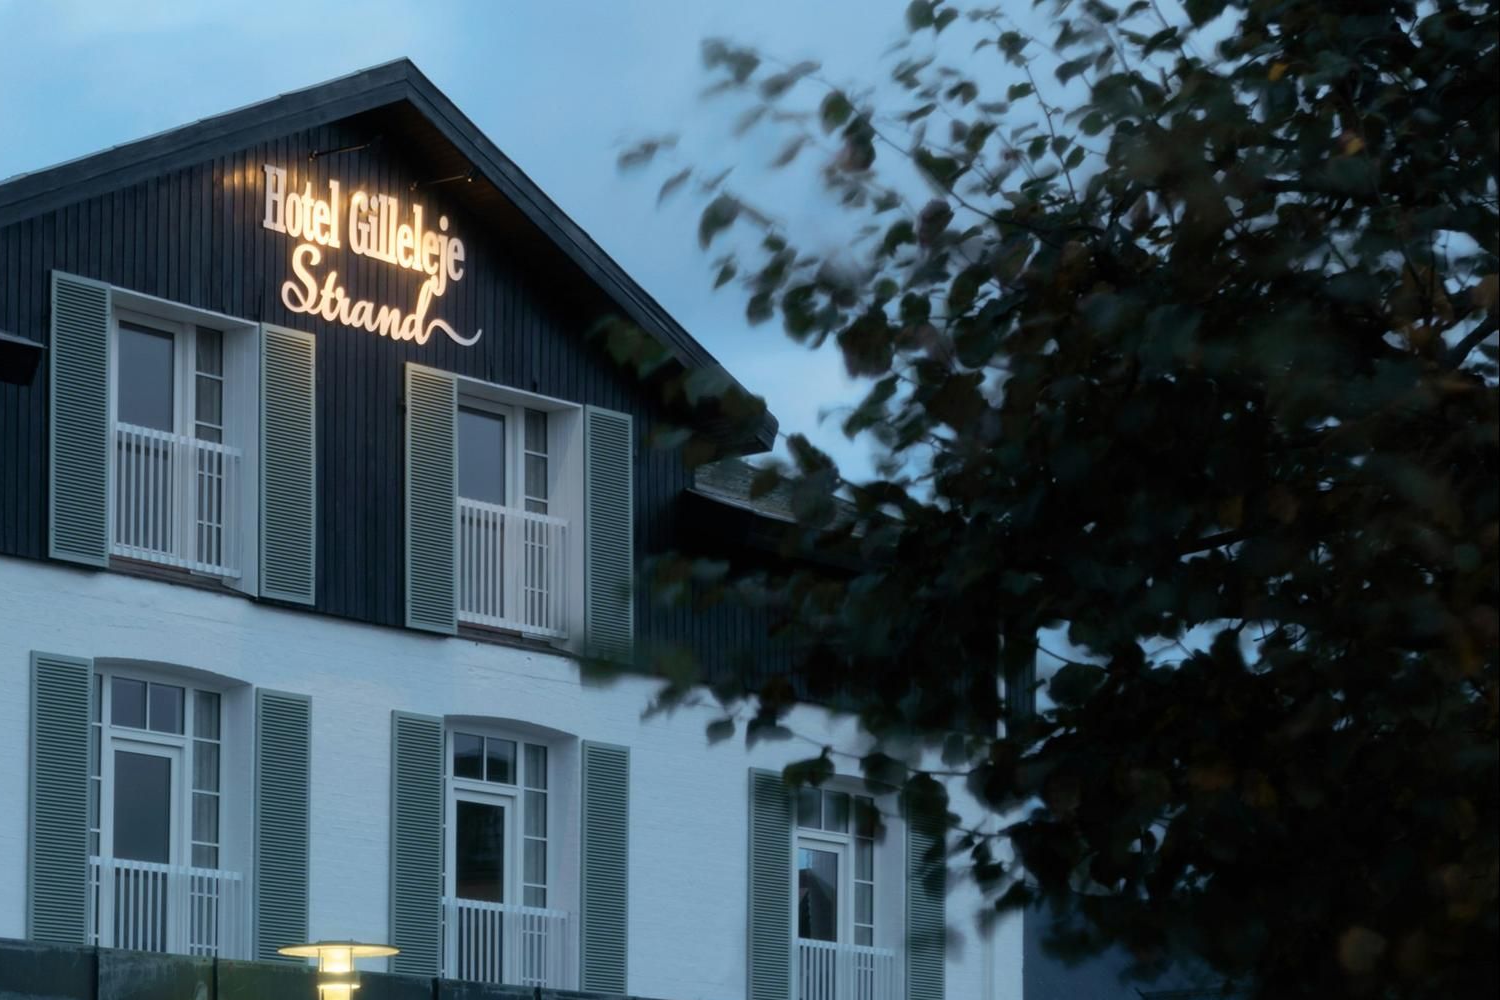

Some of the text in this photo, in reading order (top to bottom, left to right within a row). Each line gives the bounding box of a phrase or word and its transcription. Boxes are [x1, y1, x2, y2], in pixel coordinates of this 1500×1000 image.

[263, 164, 465, 296] Hotel Gilleleje
[281, 244, 482, 346] Strand
